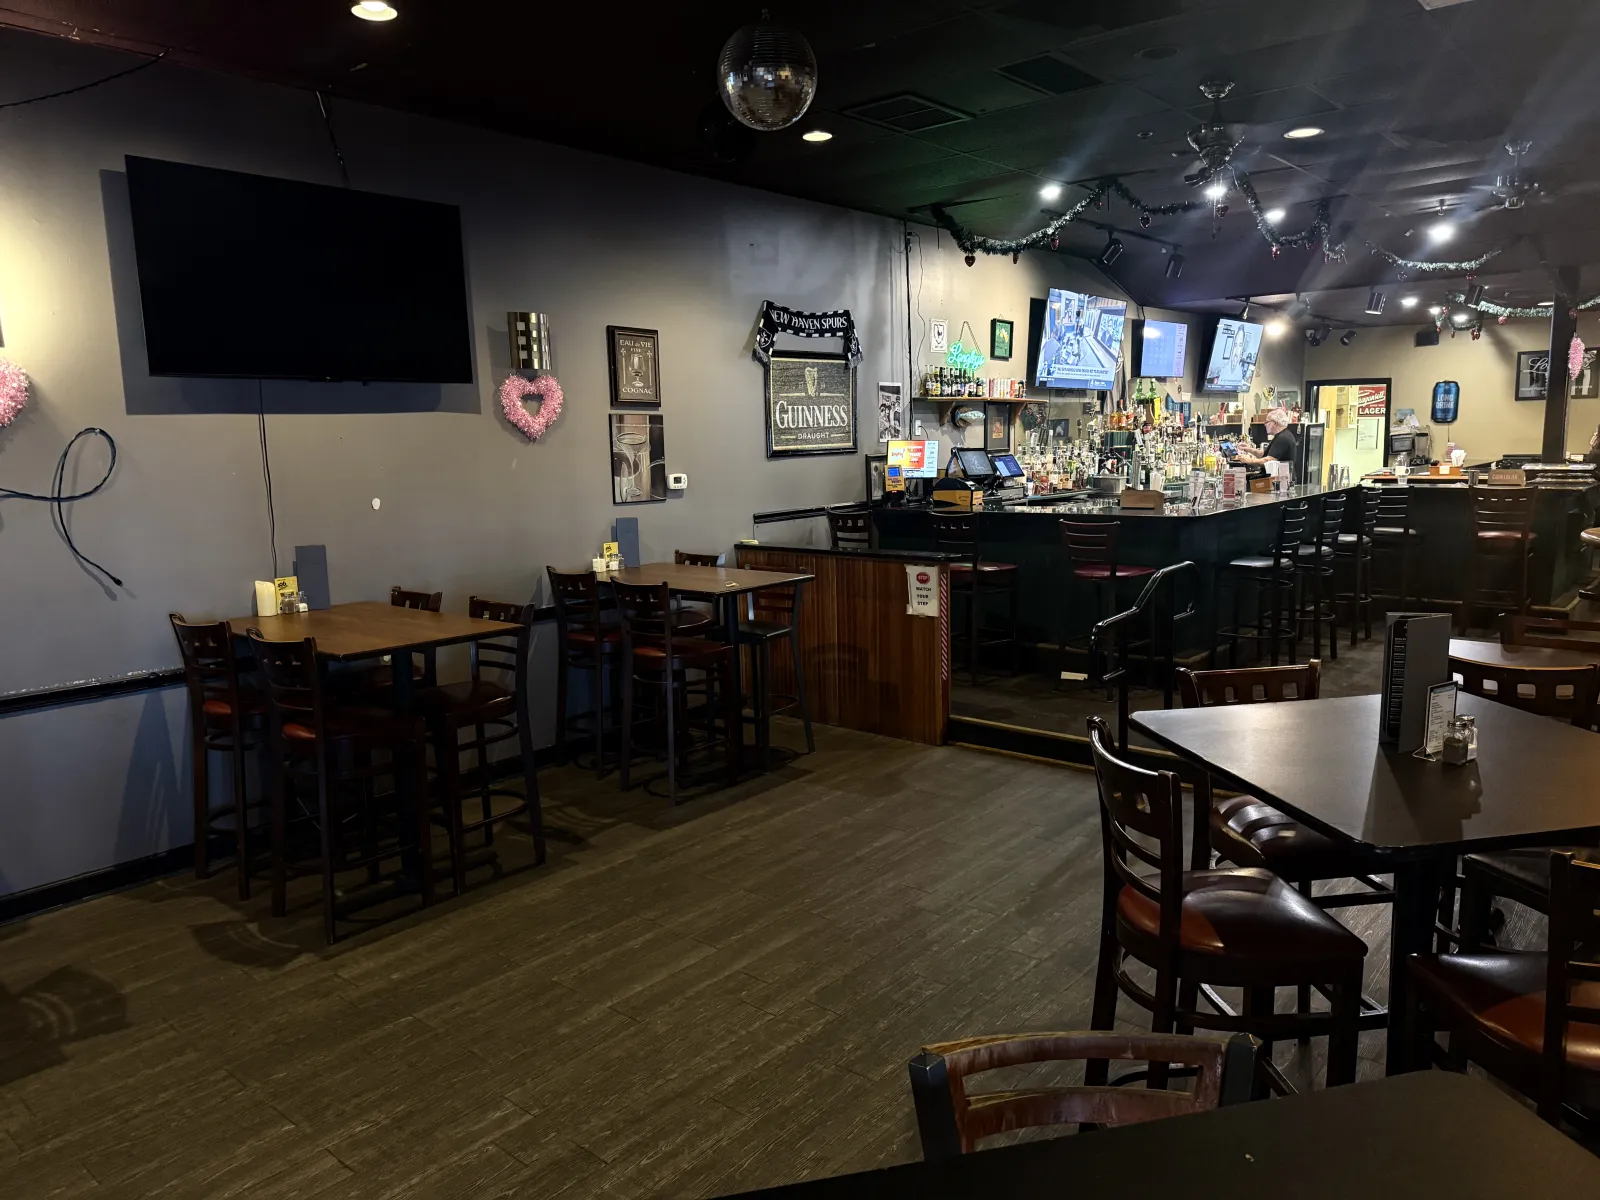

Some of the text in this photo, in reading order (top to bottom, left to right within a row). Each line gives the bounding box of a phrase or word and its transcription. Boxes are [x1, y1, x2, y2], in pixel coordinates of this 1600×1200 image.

[791, 315, 821, 329] HAVEN
[821, 316, 848, 329] SPURS
[1436, 401, 1454, 409] DRINK
[775, 401, 848, 429] GUINNESS
[1359, 407, 1386, 415] LAGER
[797, 432, 830, 440] DRAUGHT
